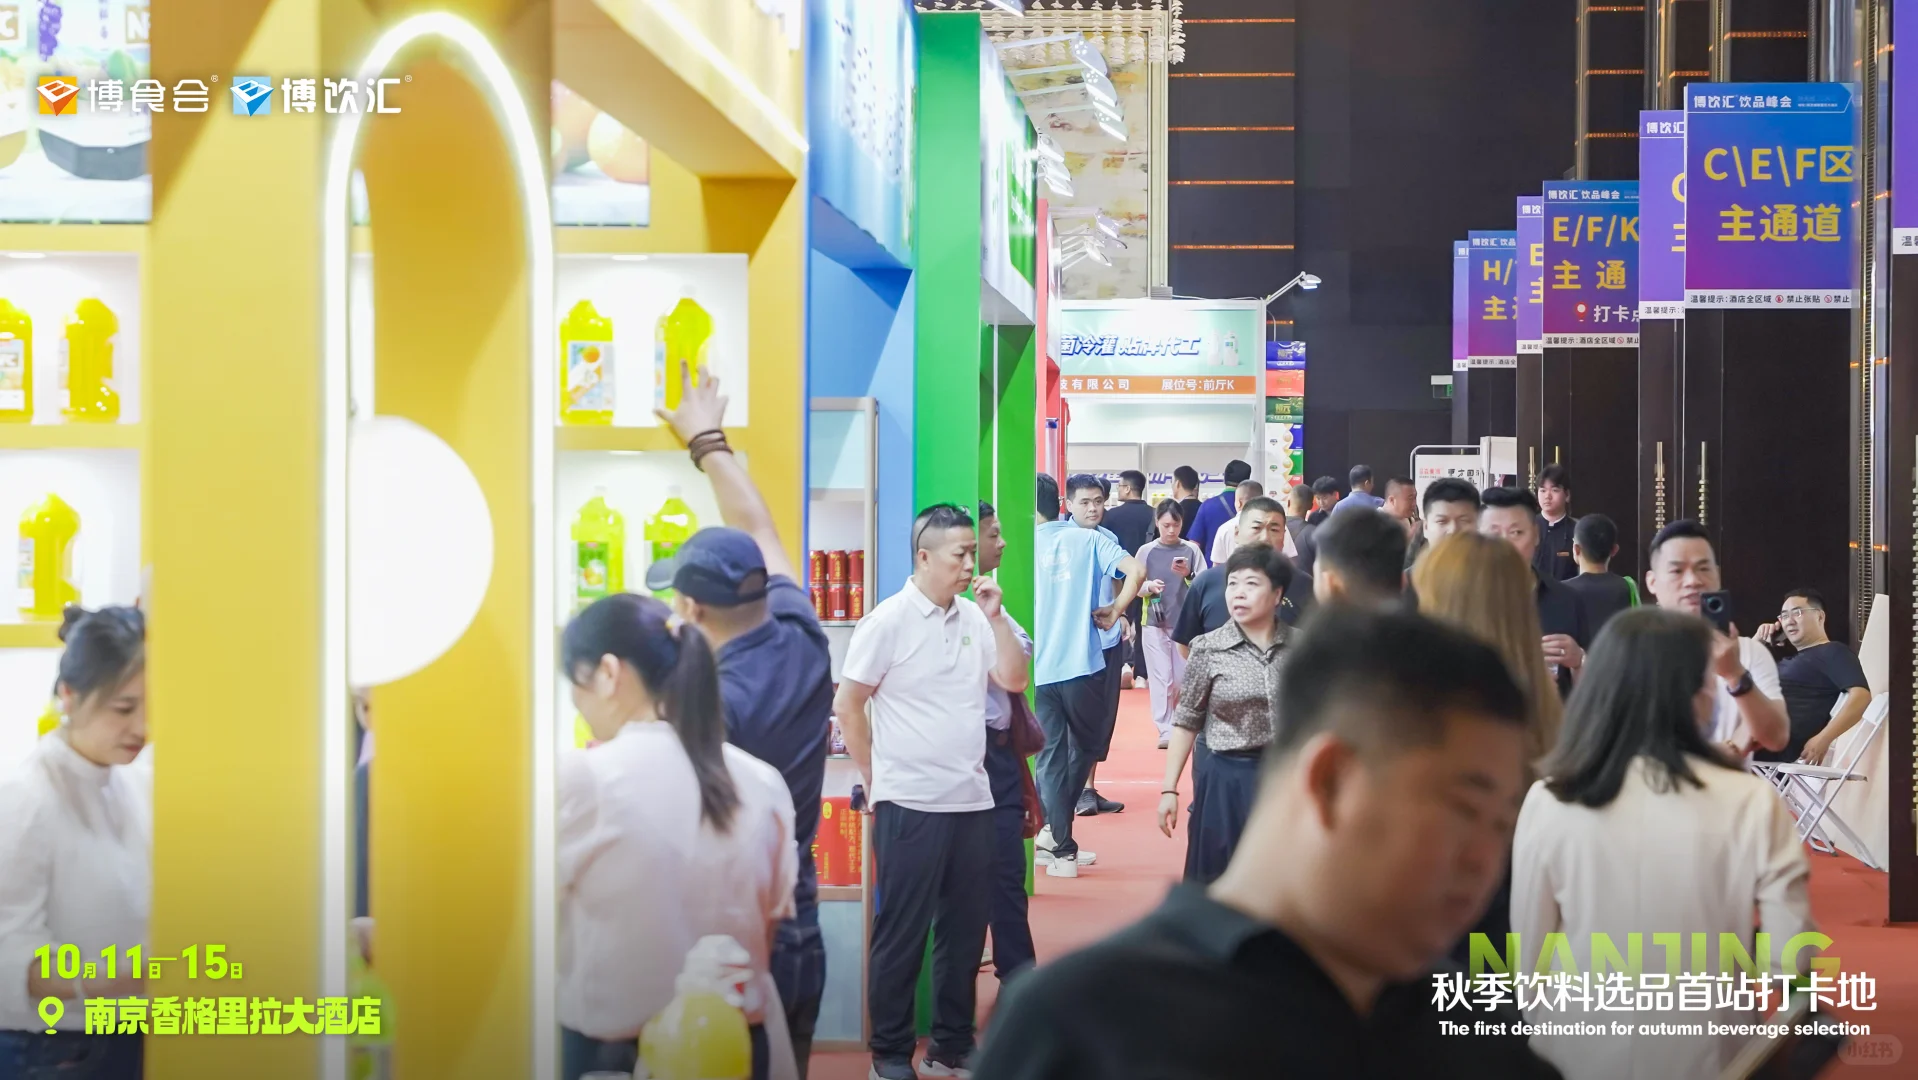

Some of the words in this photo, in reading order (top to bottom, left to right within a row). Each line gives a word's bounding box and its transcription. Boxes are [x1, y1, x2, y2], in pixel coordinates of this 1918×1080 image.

[1694, 95, 1736, 108] 博饮汇
[1739, 95, 1792, 108] 饮品峰会
[1548, 190, 1579, 200] 博饮汇
[1581, 190, 1620, 200] 饮品峰会
[1553, 214, 1640, 248] E/F/K
[1718, 203, 1842, 242] 主通道
[1786, 294, 1821, 304] 禁止张贴
[1119, 336, 1201, 357] 贴牌代工
